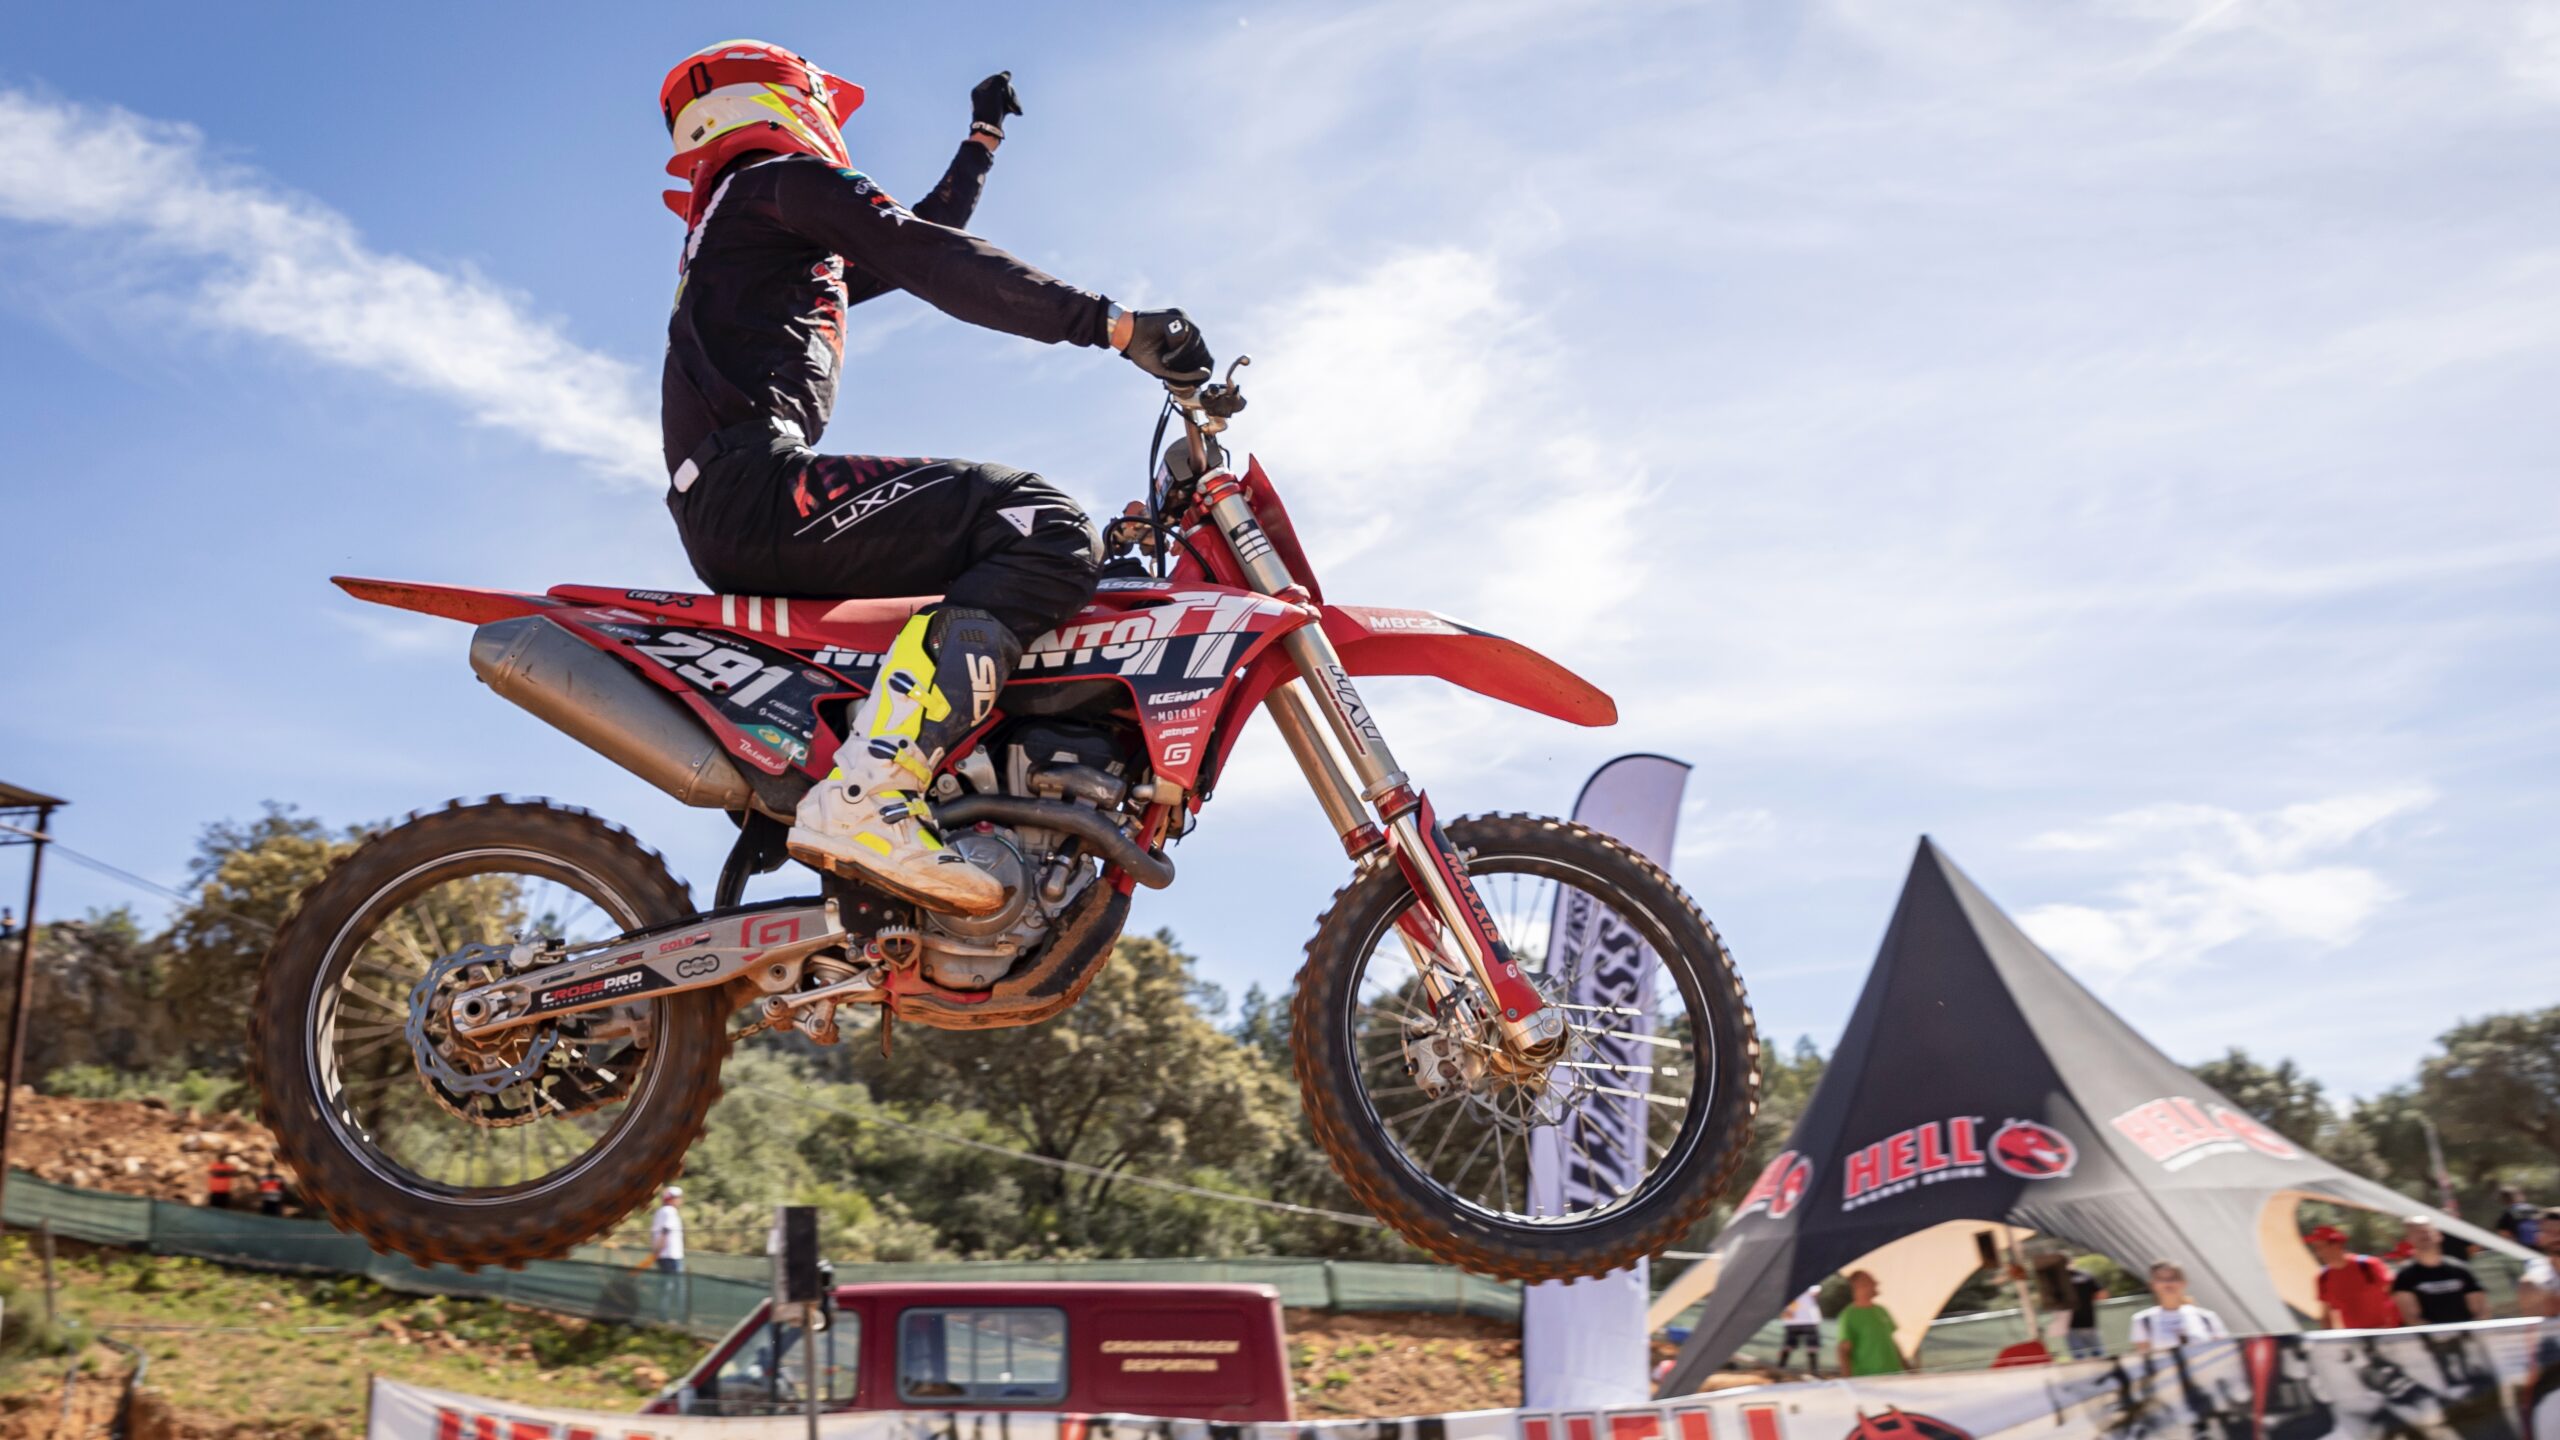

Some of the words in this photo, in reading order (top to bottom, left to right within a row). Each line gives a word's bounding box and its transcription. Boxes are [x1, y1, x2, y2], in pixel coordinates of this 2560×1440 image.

[1096, 580, 1174, 591] ASGAS
[634, 632, 794, 708] 291
[1148, 687, 1215, 706] KENNY
[1443, 853, 1499, 943] MAXXIS
[541, 971, 643, 1004] CROSSPRO
[1844, 1115, 1986, 1201] HELL
